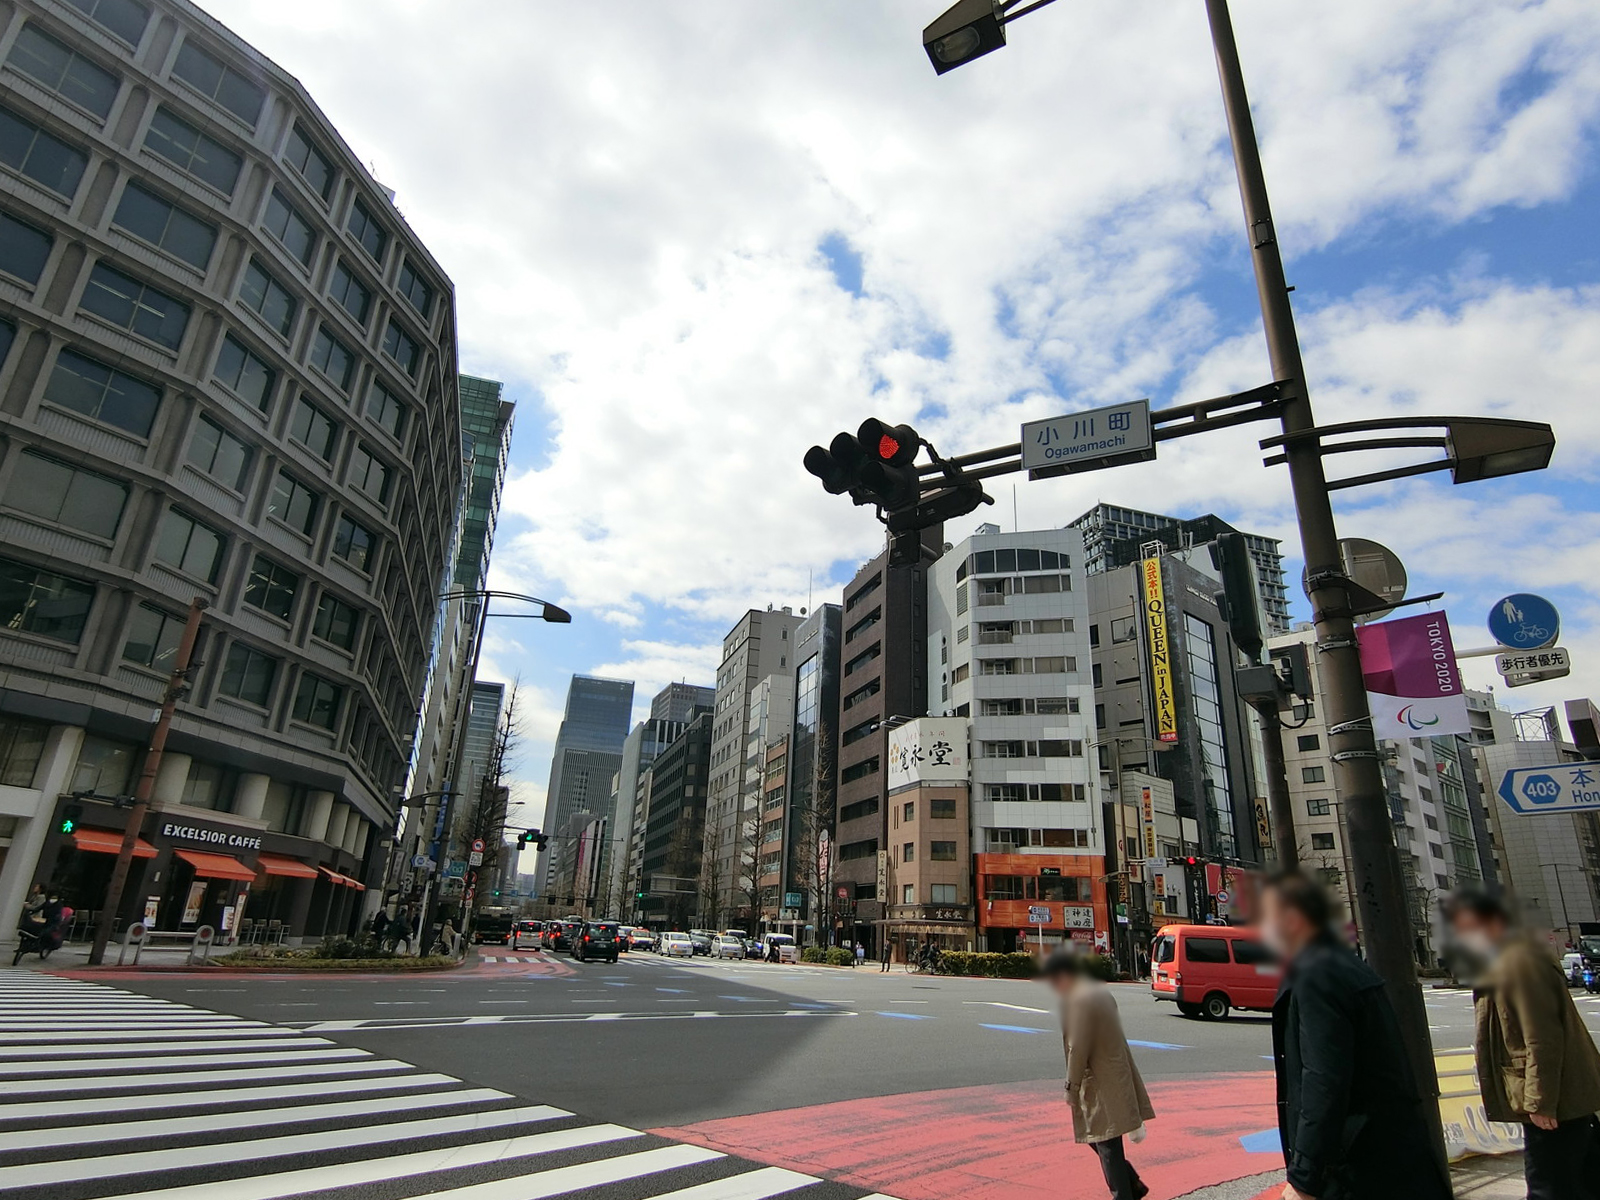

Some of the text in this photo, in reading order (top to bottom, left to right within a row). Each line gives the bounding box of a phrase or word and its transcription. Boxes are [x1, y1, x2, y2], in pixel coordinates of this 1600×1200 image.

[1037, 411, 1131, 446] 小川町
[1045, 434, 1126, 459] Ogawamachi
[1148, 599, 1173, 732] QUEEN in JAPAN
[1426, 621, 1453, 692] TOKYO 2020
[1501, 652, 1564, 671] 歩行者優先
[1527, 781, 1557, 797] 403
[1569, 768, 1600, 788] 本
[163, 824, 261, 849] EXCELSIOR CAFFÉ
